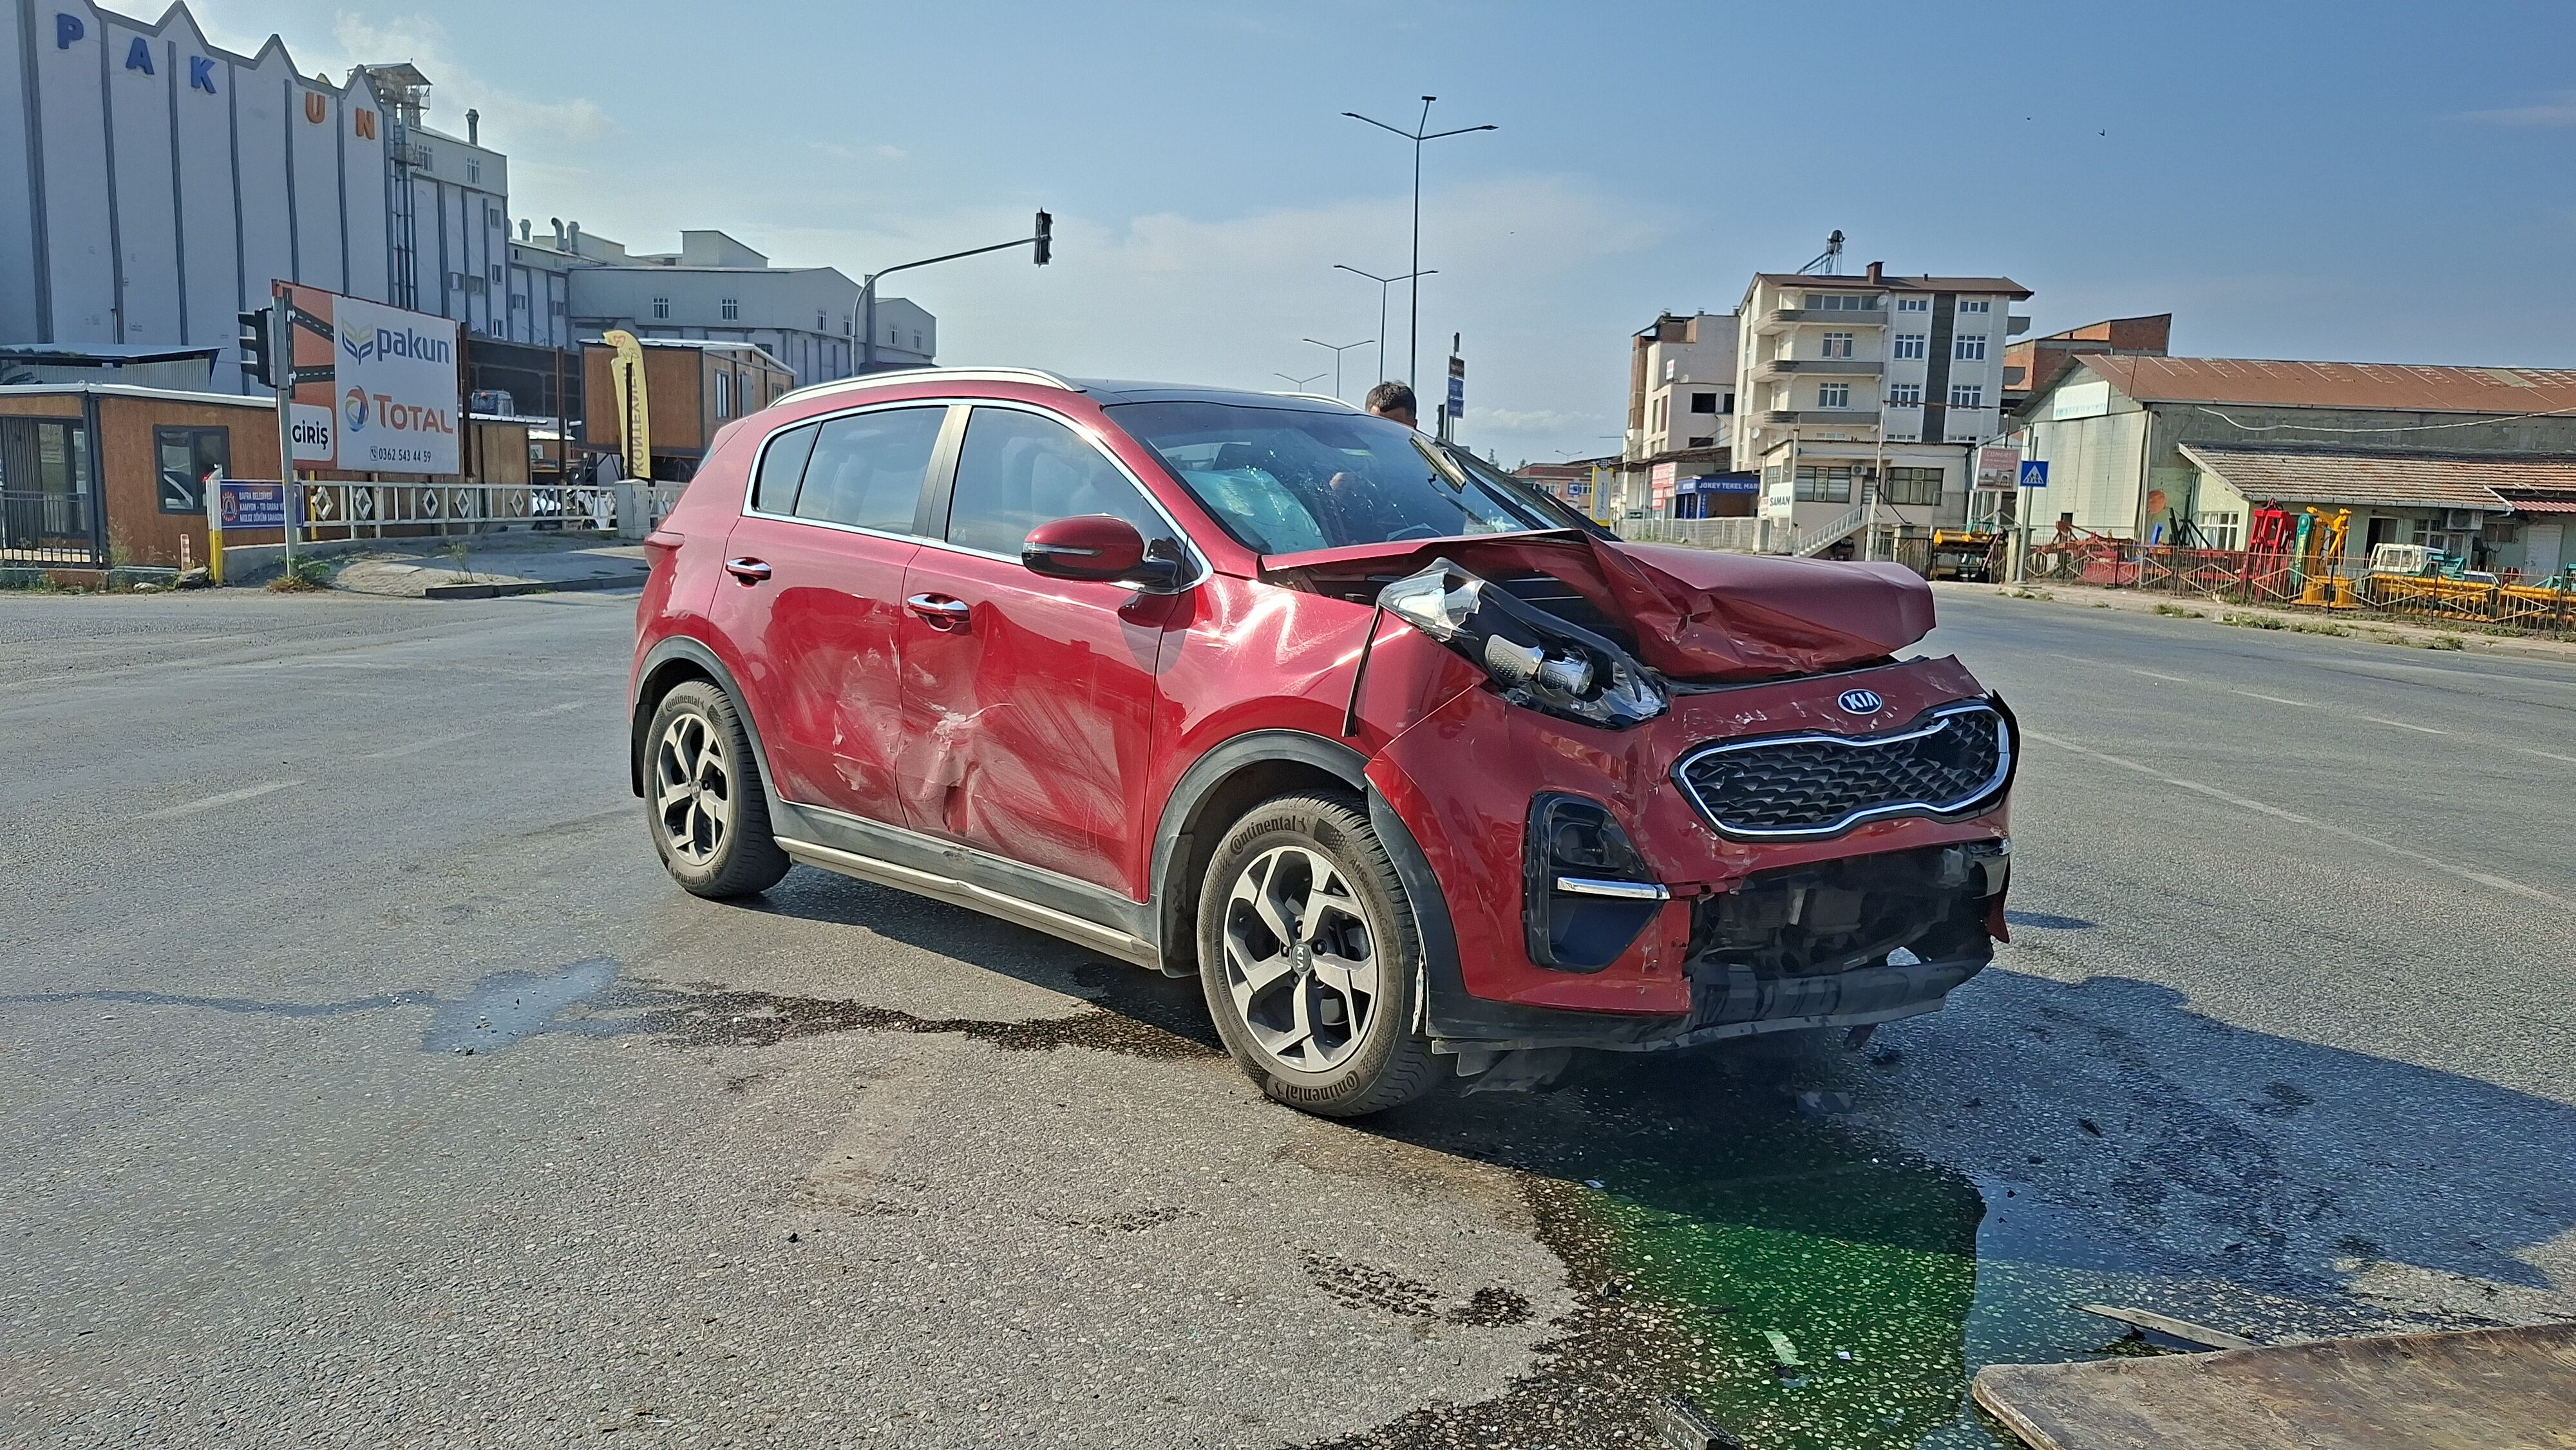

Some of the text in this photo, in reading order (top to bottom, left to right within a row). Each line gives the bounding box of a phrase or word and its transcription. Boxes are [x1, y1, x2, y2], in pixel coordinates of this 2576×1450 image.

[377, 327, 450, 364] pakun
[373, 393, 453, 434] TOTAL
[292, 419, 328, 450] GİRİŞ
[379, 447, 431, 463] 0362 543 44 59
[1770, 496, 1790, 507] SAMAN
[665, 694, 701, 712] Continental
[1844, 692, 1879, 710] KIA
[1229, 815, 1296, 855] Continental
[675, 870, 711, 887] Continental
[1287, 1069, 1361, 1103] Continental
